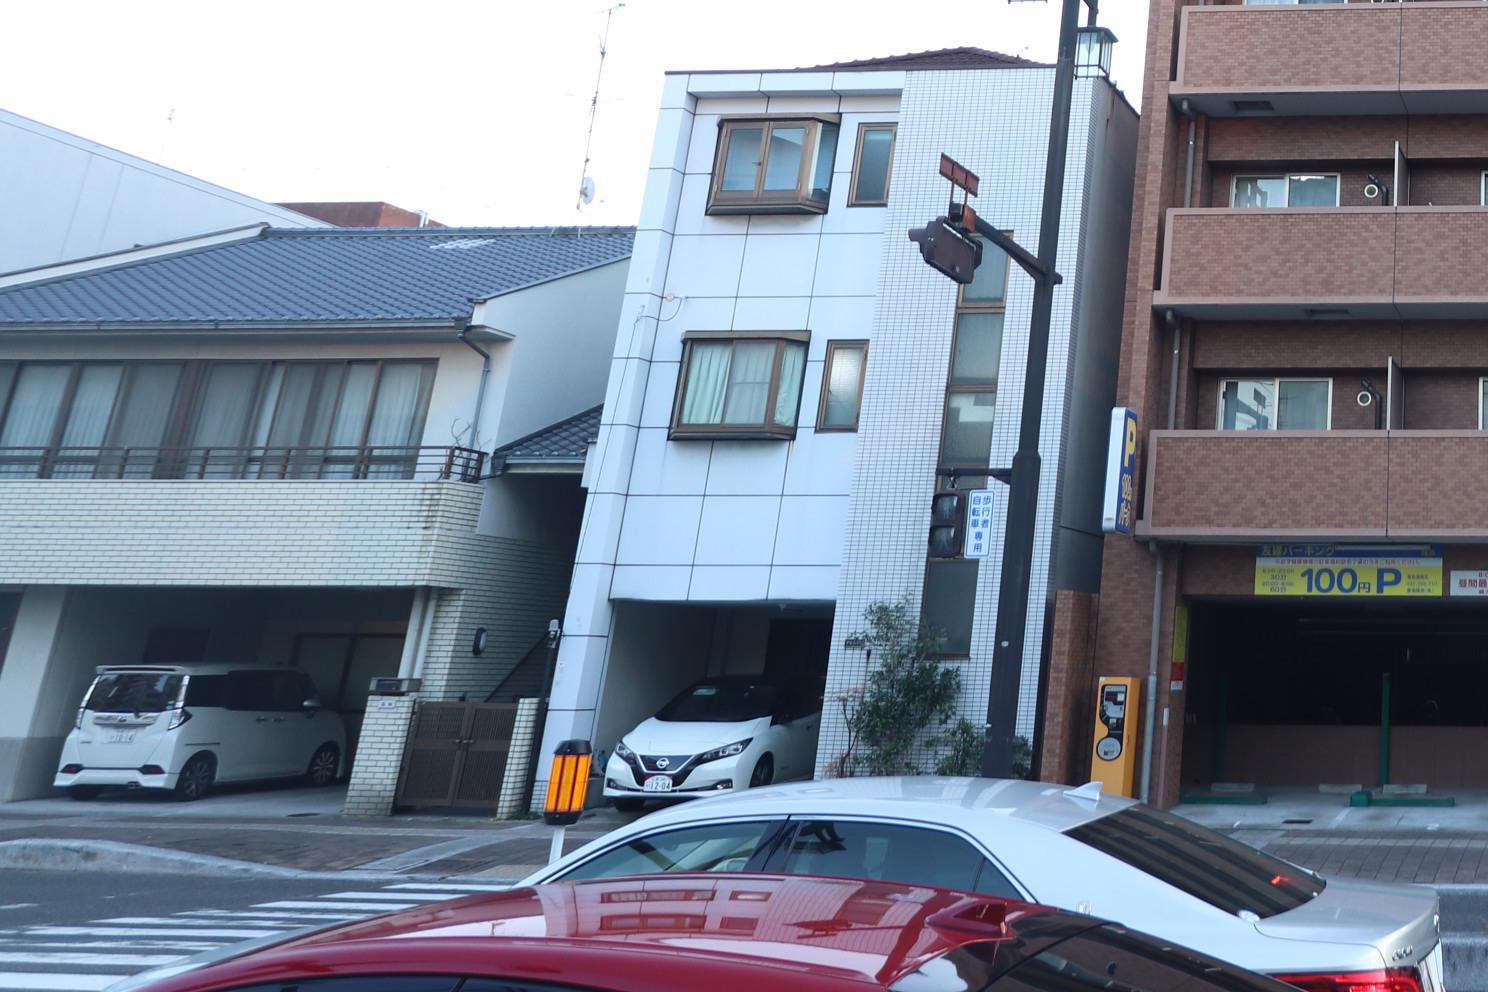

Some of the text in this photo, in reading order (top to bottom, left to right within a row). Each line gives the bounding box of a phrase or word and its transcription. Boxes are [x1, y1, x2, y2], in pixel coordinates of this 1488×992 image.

[1124, 417, 1136, 467] P
[971, 496, 981, 528] 自転車
[981, 496, 990, 529] 歩行者
[973, 531, 983, 553] 専用
[1301, 568, 1371, 594] 100円
[1376, 568, 1402, 594] P
